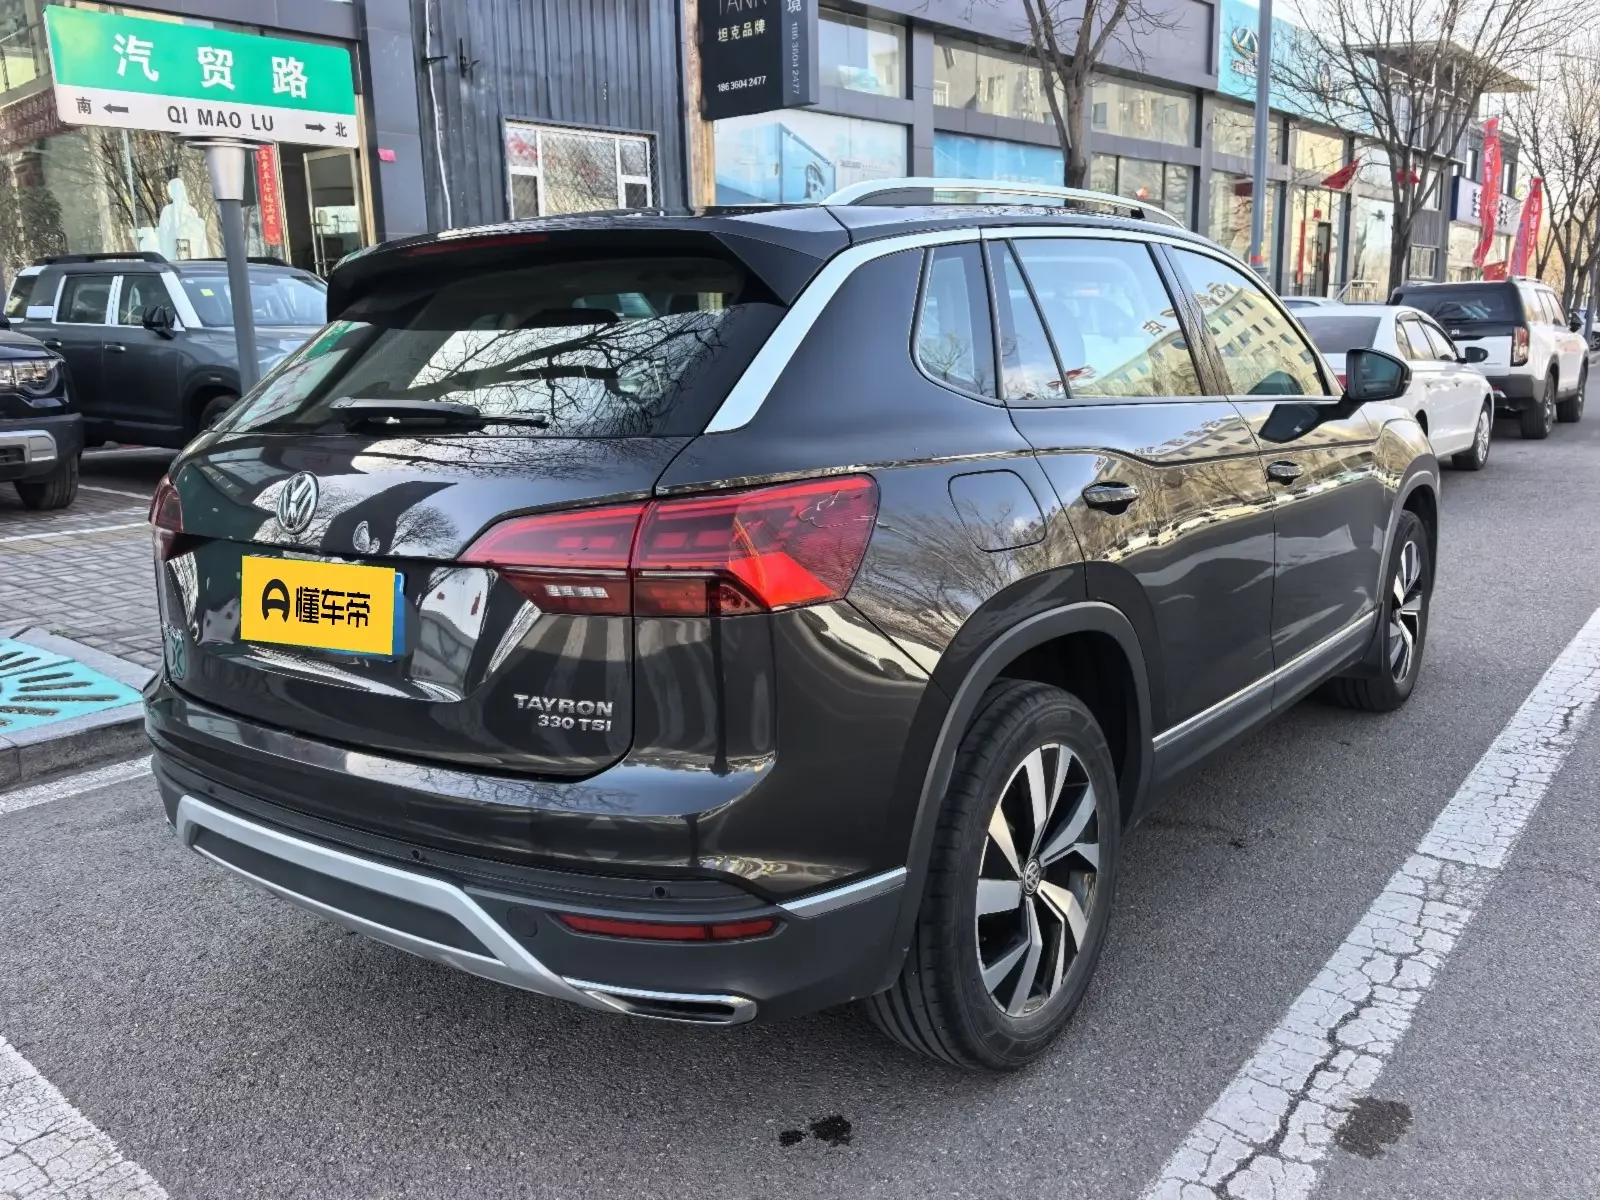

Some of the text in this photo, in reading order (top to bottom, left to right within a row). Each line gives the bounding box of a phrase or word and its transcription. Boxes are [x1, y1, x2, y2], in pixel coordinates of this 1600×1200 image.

[718, 18, 765, 42] 坦克品牌
[113, 33, 309, 99] 汽贸路
[717, 75, 767, 92] 186 3604 2477
[75, 96, 92, 115] 南
[167, 105, 274, 132] QI MAO LU
[335, 121, 348, 138] 北
[513, 693, 614, 717] TAYRON
[537, 714, 612, 732] 330 TSI
